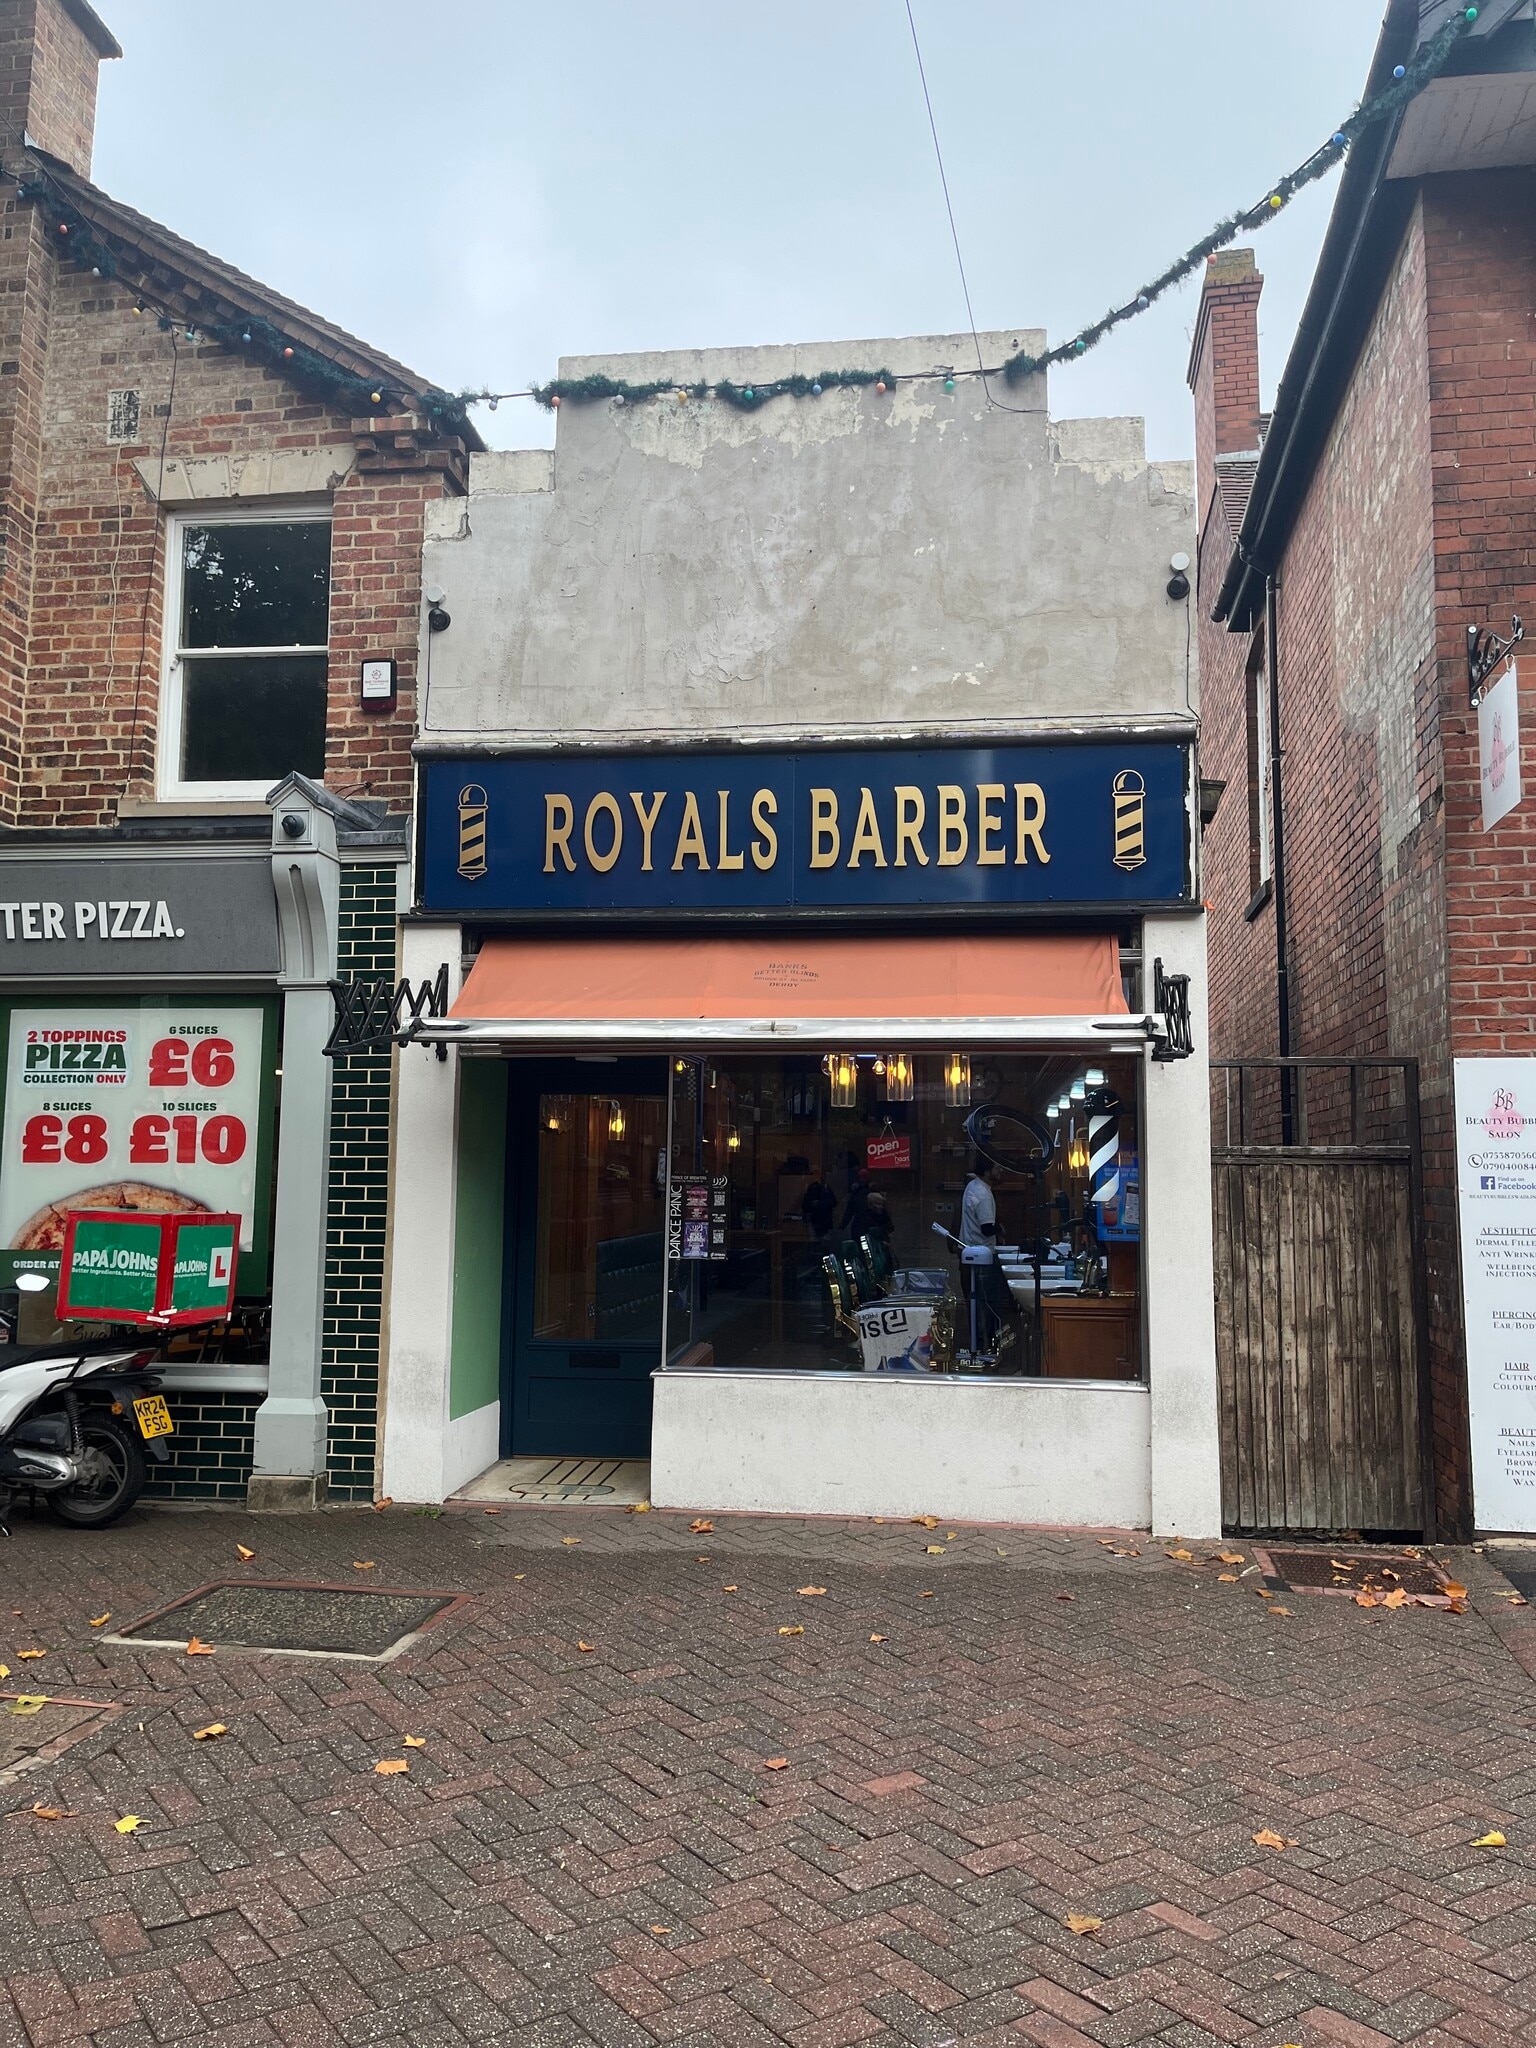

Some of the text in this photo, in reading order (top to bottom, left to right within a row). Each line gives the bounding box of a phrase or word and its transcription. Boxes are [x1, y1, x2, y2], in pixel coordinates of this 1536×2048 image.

[543, 783, 1051, 872] ROYALS BARBER
[0, 900, 185, 939] TER PIZZA.
[27, 1030, 127, 1042] 2 TOPPINGS
[169, 1026, 218, 1034] 6 SLICES
[26, 1044, 127, 1069] PIZZA
[149, 1038, 235, 1088] £6
[24, 1075, 126, 1084] COLLECTION ONLY
[43, 1102, 92, 1111] 8 SLICES
[162, 1103, 217, 1111] 10 SLICES
[1466, 1116, 1536, 1125] BEAUTY BUBB
[22, 1115, 108, 1163] £8
[130, 1115, 247, 1164] £10
[1488, 1130, 1520, 1139] SALON
[867, 1140, 900, 1156] Open
[669, 1185, 683, 1259] DANCE PANIC
[72, 1250, 158, 1271] PAPA JOHNS
[1479, 1250, 1500, 1258] ANTI
[13, 1260, 60, 1269] ORDER AT
[174, 1260, 208, 1274] APA JOHNS
[215, 1255, 226, 1278] L
[90, 1268, 122, 1276] Ingredients.
[1493, 1322, 1536, 1330] EAR/BOD
[1504, 1362, 1530, 1371] HAIR
[1493, 1383, 1536, 1391] COLOURI
[135, 1398, 165, 1417] KR24
[144, 1415, 168, 1433] FSG
